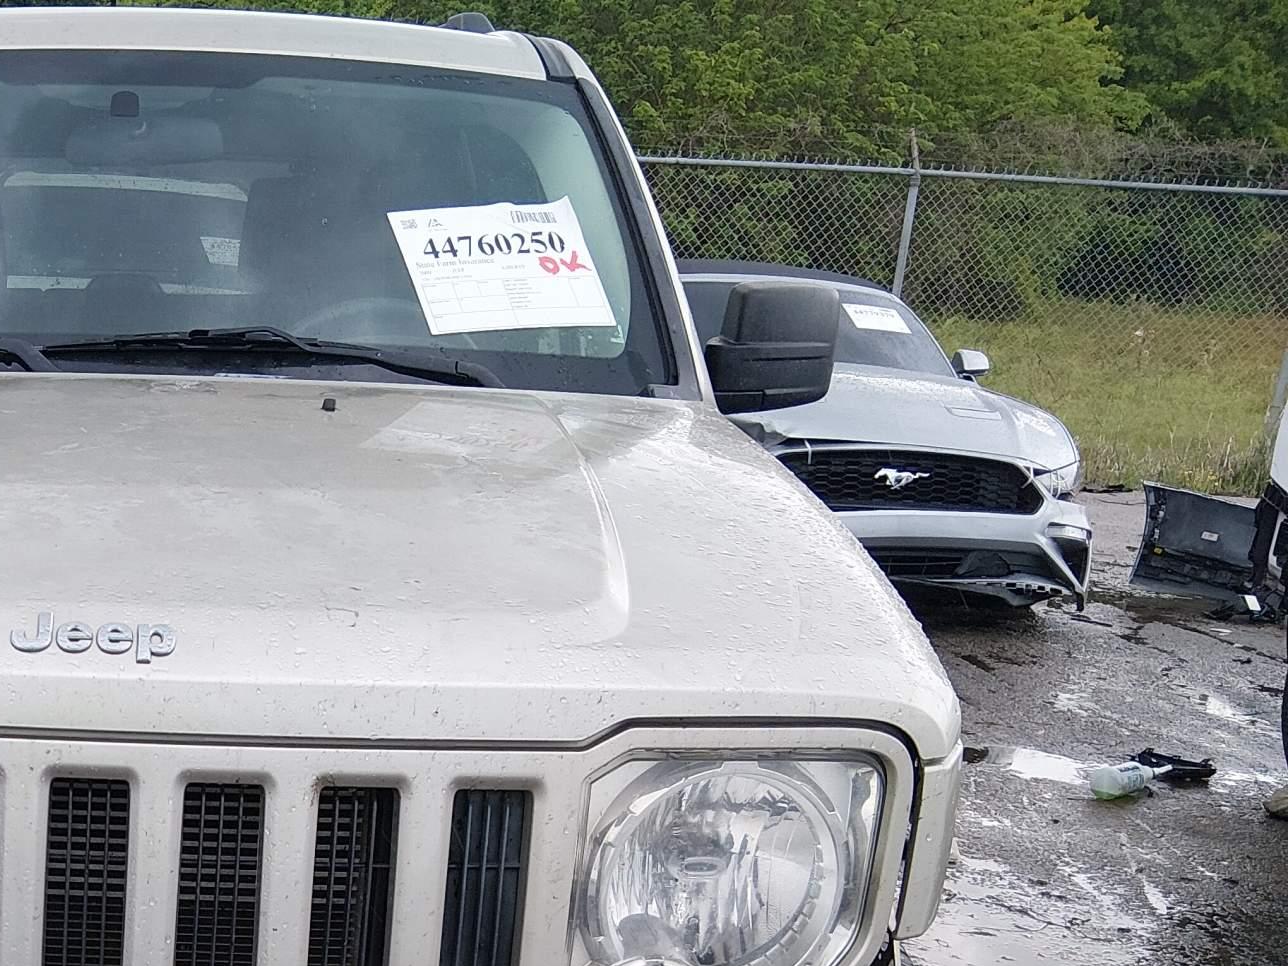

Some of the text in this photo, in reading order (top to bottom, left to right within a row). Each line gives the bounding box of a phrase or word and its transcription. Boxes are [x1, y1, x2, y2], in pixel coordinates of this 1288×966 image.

[423, 231, 565, 258] 44760250
[538, 250, 593, 275] OK
[10, 611, 177, 664] Jeep
